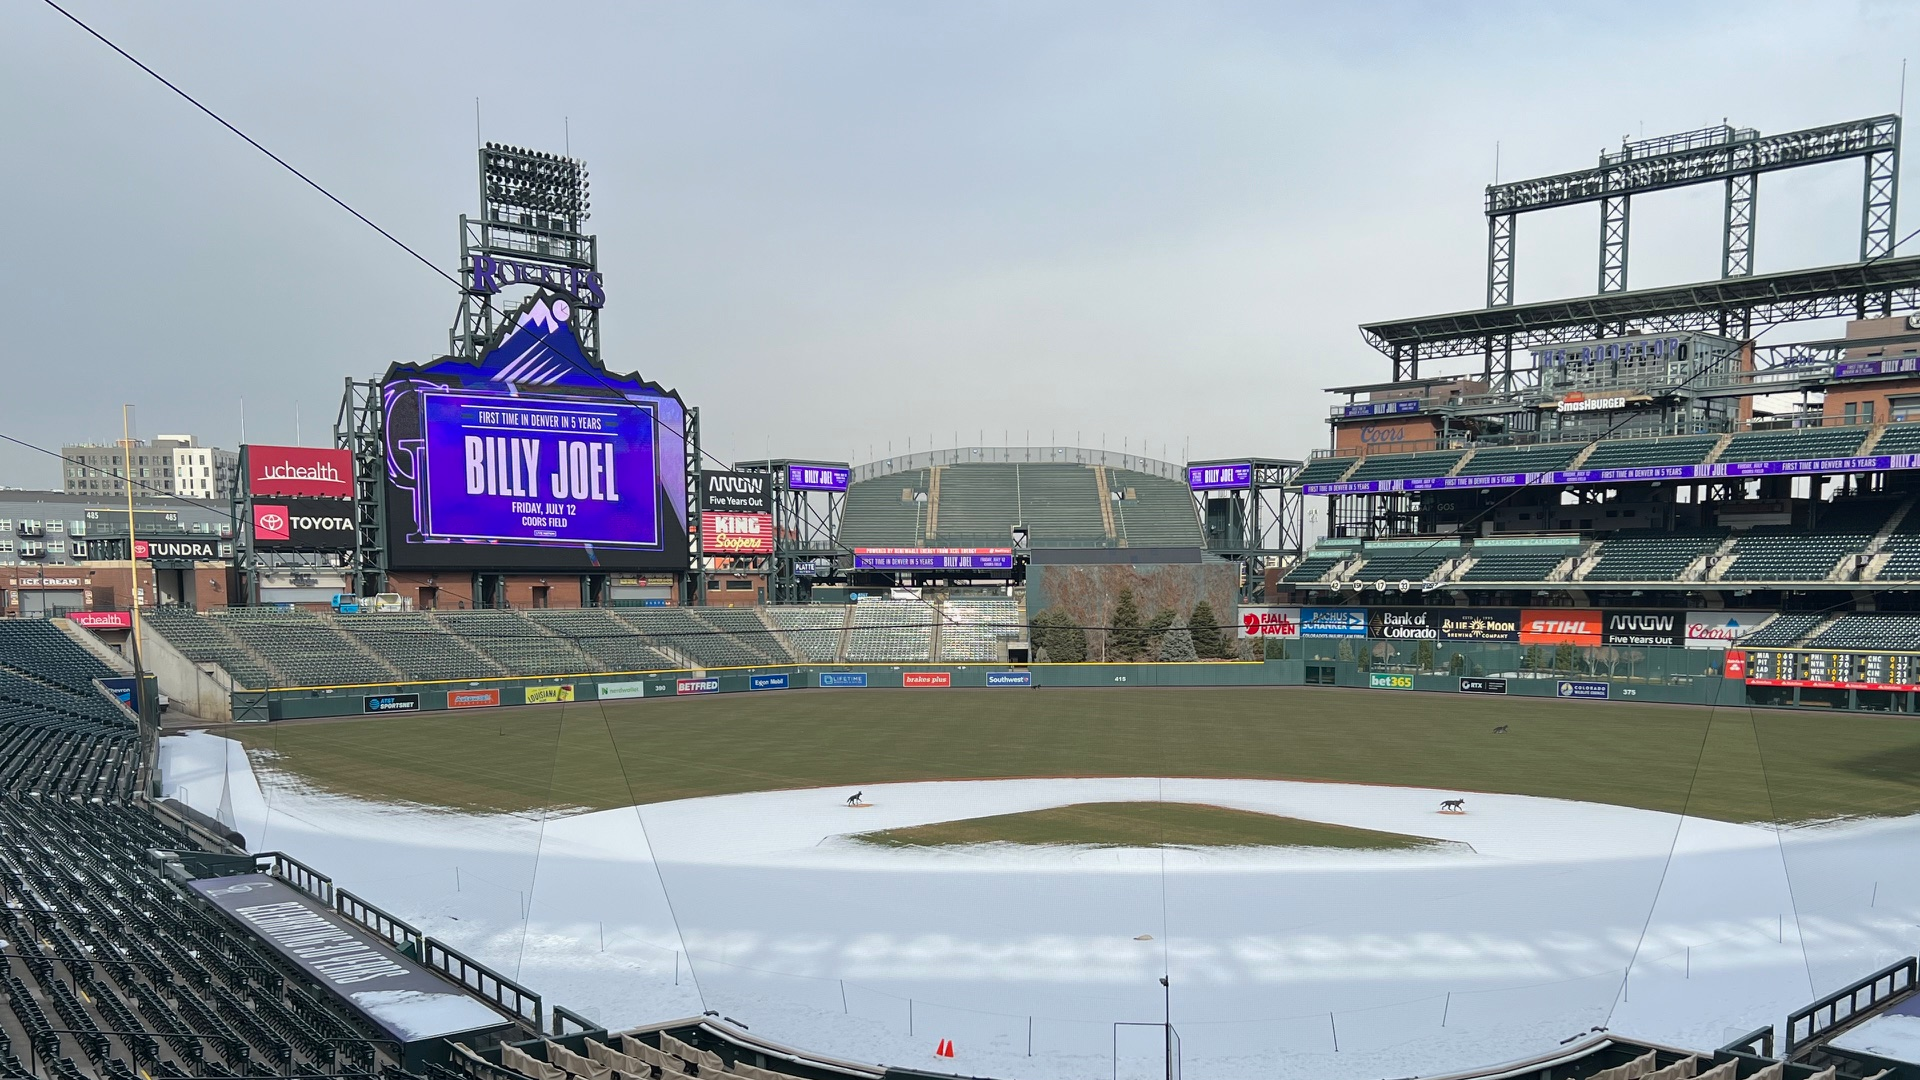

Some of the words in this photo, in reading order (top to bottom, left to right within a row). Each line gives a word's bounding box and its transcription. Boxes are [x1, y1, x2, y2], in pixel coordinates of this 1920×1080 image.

[469, 254, 606, 308] ROCKIES
[1531, 349, 1566, 368] THE
[1582, 338, 1679, 364] ROOFTOP
[478, 411, 500, 424] FIRST
[502, 412, 518, 425] TIME
[521, 414, 529, 426] IN
[531, 414, 558, 427] DENVER
[562, 416, 569, 428] IN
[572, 417, 576, 428] 5
[578, 417, 601, 429] YEARS
[1361, 426, 1404, 442] Coors
[1800, 462, 1811, 470] TIME
[1821, 461, 1842, 469] DENVER
[1844, 460, 1849, 468] IN
[1852, 460, 1856, 468] 5
[1858, 458, 1876, 467] YEARS
[1891, 455, 1910, 468] BILLY
[265, 460, 338, 480] uchealth
[465, 436, 540, 497] BILLY
[552, 440, 619, 501] JOEL
[1694, 465, 1711, 476] BILLY
[1712, 464, 1727, 475] JOEL
[804, 470, 819, 483] BILLY
[820, 470, 833, 484] JOEL
[1205, 469, 1219, 483] BILLY
[1221, 469, 1234, 482] JOEL
[1526, 472, 1539, 484] BILLY
[1379, 480, 1391, 490] BILLY
[710, 496, 726, 505] Five
[727, 496, 747, 506] Years
[748, 498, 763, 506] Out
[512, 502, 543, 515] FRIDAY,
[546, 503, 564, 515] JULY
[567, 504, 576, 515] 12
[290, 517, 354, 530] TOYOTA
[522, 516, 547, 526] COORS
[549, 517, 567, 527] FIELD
[715, 516, 760, 534] KING
[715, 534, 761, 551] Soopers
[149, 543, 213, 556] TUNDRA
[796, 563, 814, 571] PLATTE
[944, 557, 958, 566] BILLY
[959, 557, 972, 566] JOEL
[76, 614, 121, 625] uchealth
[1384, 612, 1413, 625] Bank
[1415, 612, 1427, 625] of
[1384, 626, 1436, 638] Colorado
[1442, 619, 1467, 632] BLUE
[1487, 621, 1515, 631] MOON
[1530, 621, 1590, 634] STIHL
[1689, 623, 1732, 639] Coors
[1610, 635, 1628, 644] Five
[678, 681, 718, 692] BETFRED
[1372, 676, 1411, 686] bet365
[528, 690, 556, 703] LOUISIANA
